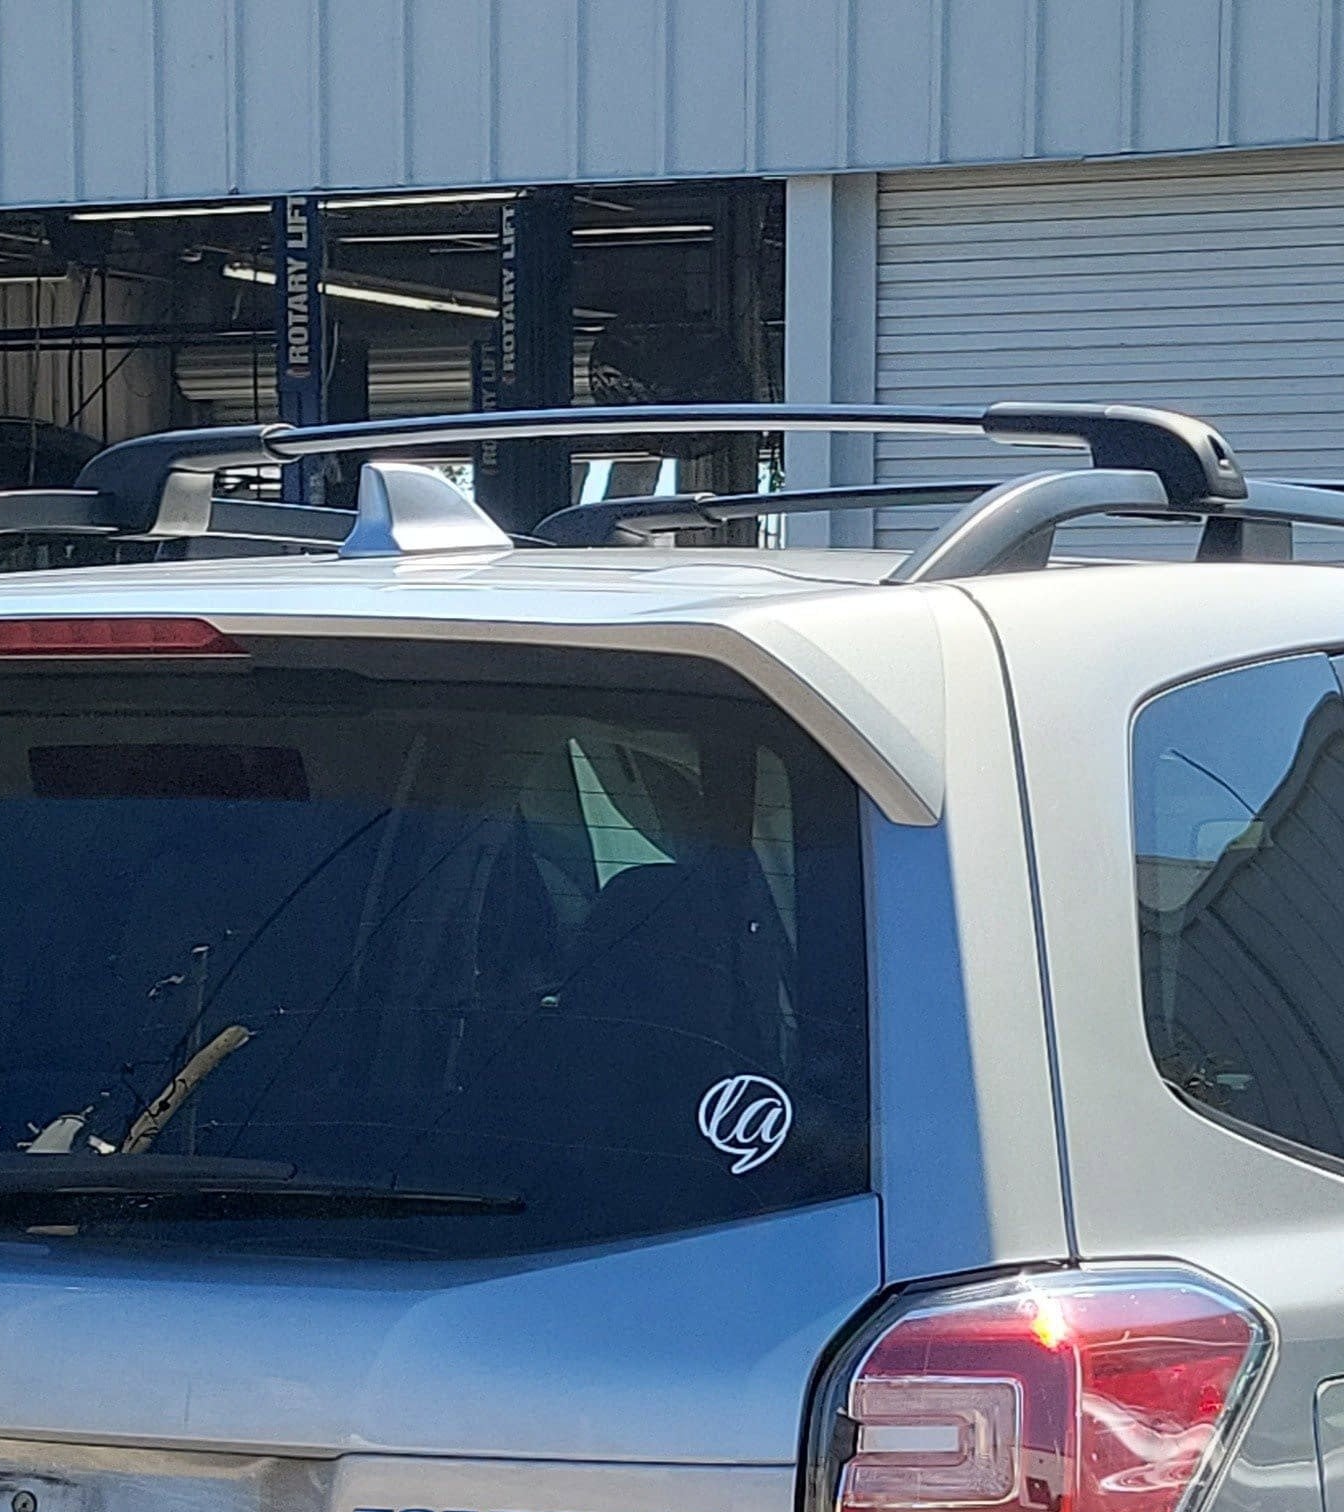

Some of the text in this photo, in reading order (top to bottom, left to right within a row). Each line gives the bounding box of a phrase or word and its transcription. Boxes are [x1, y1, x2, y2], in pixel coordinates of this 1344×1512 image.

[286, 195, 309, 364] ROTARY LIFT
[502, 204, 516, 371] ROTARY LIFT
